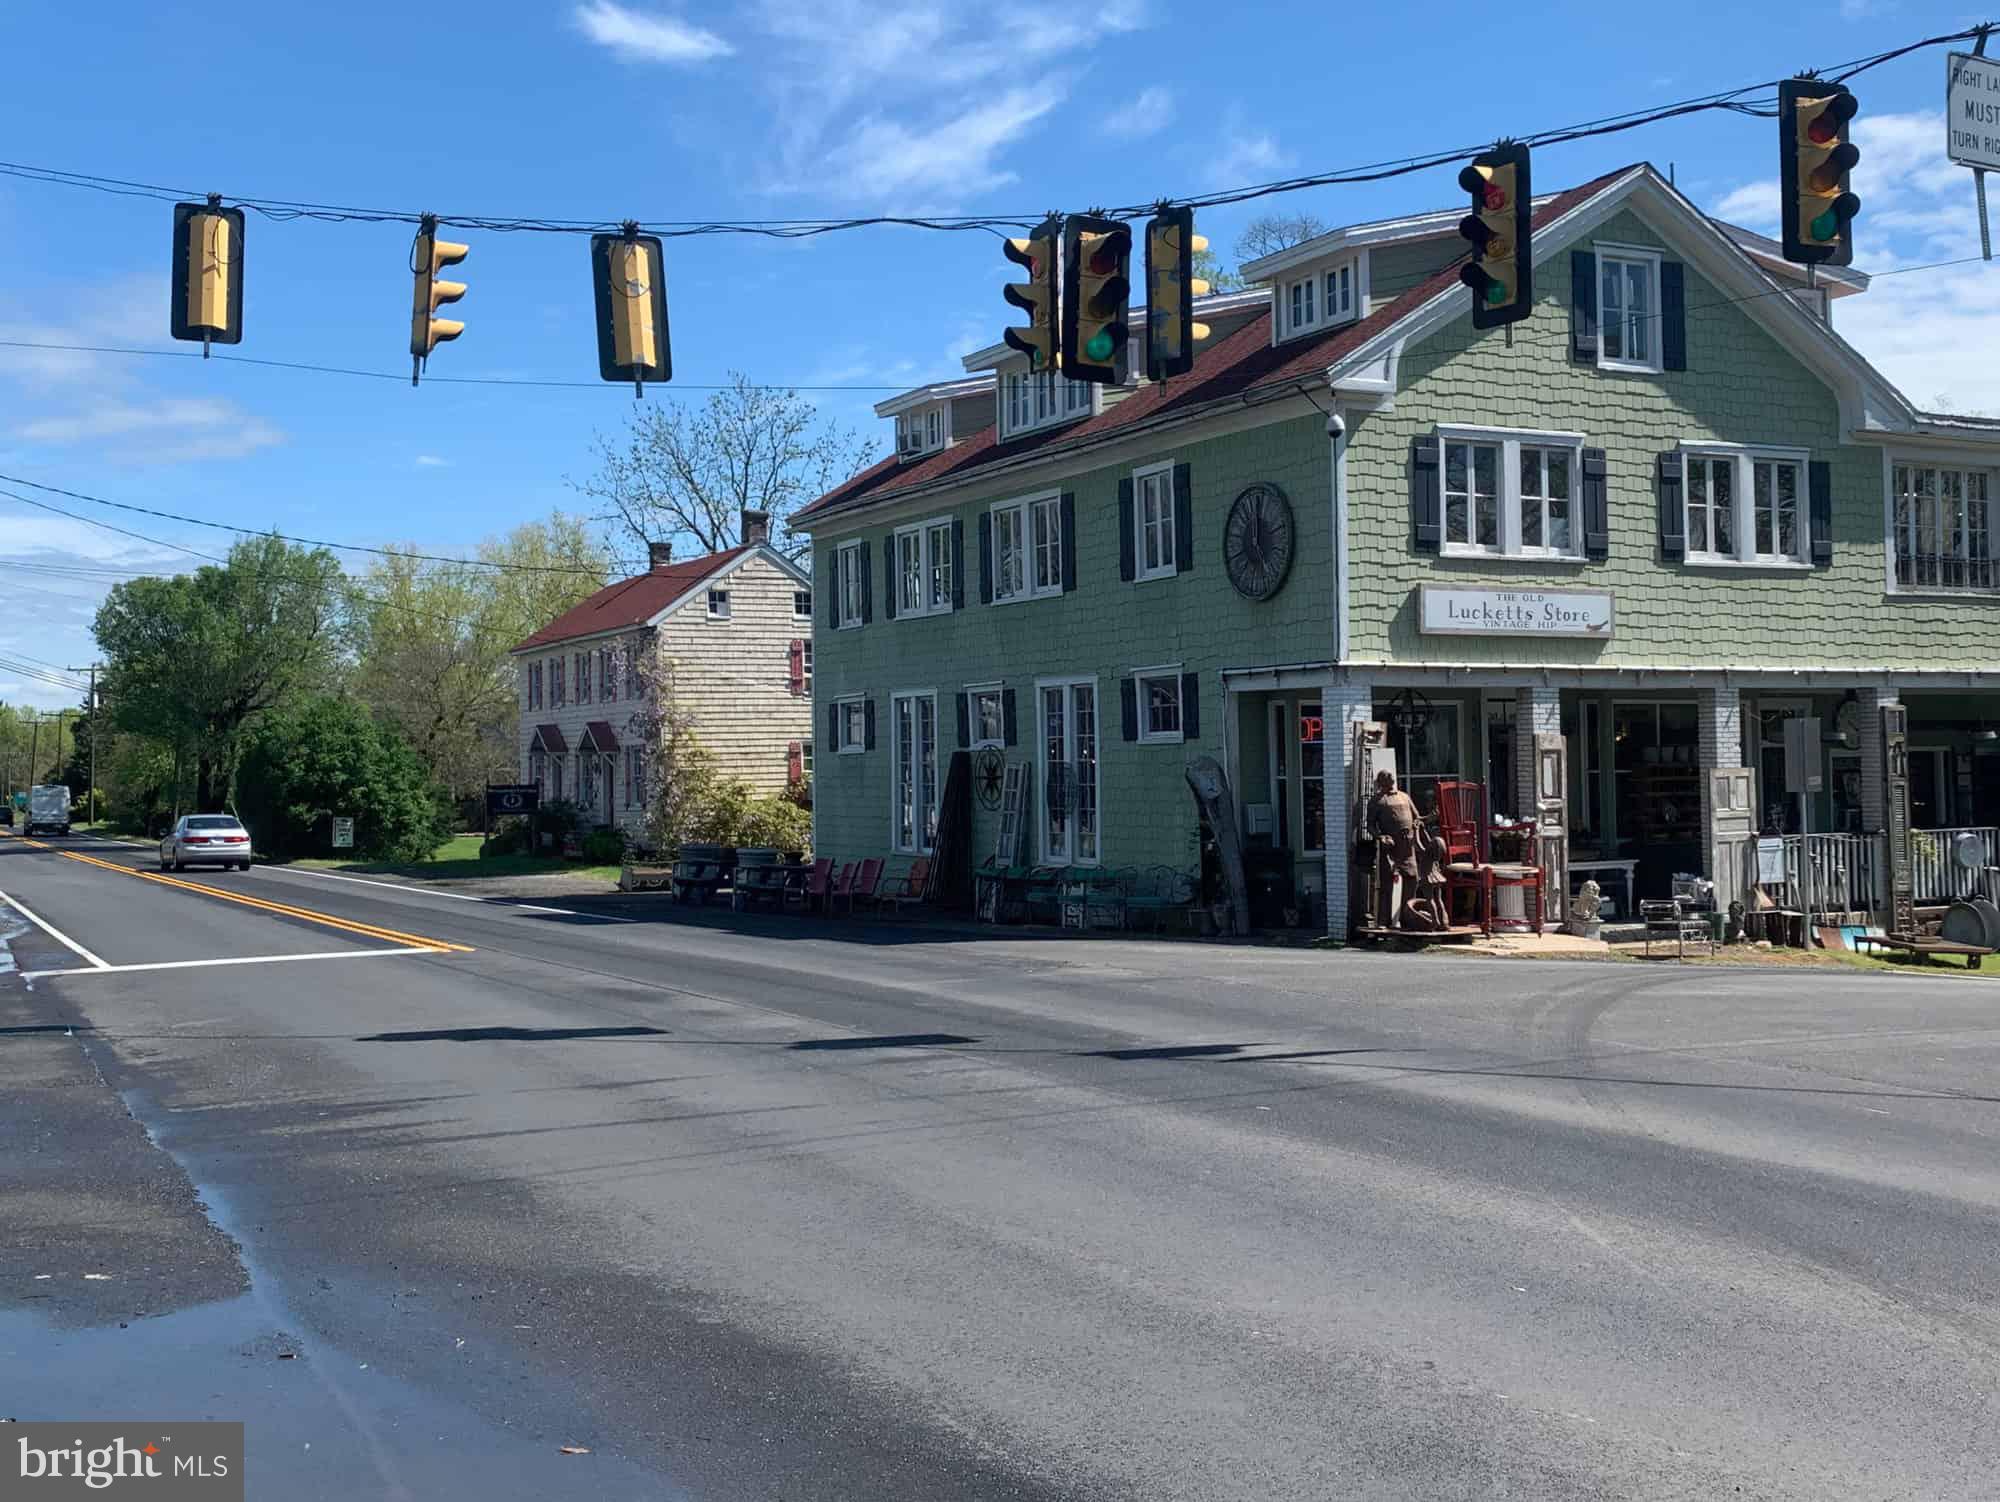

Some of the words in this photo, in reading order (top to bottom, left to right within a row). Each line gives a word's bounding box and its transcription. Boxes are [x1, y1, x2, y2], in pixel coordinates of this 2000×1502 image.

[1953, 66, 1981, 89] RIGHT
[1986, 74, 2000, 93] LA
[1965, 99, 2000, 126] MUST
[1952, 130, 1979, 150] TURN
[1985, 136, 2000, 155] RIG
[1496, 593, 1516, 602] THE
[1522, 594, 1544, 603] OLD
[1449, 600, 1534, 621] Lucketts
[1544, 602, 1590, 622] Store
[1483, 620, 1530, 629] VINTAGE
[1537, 621, 1558, 630] HIP
